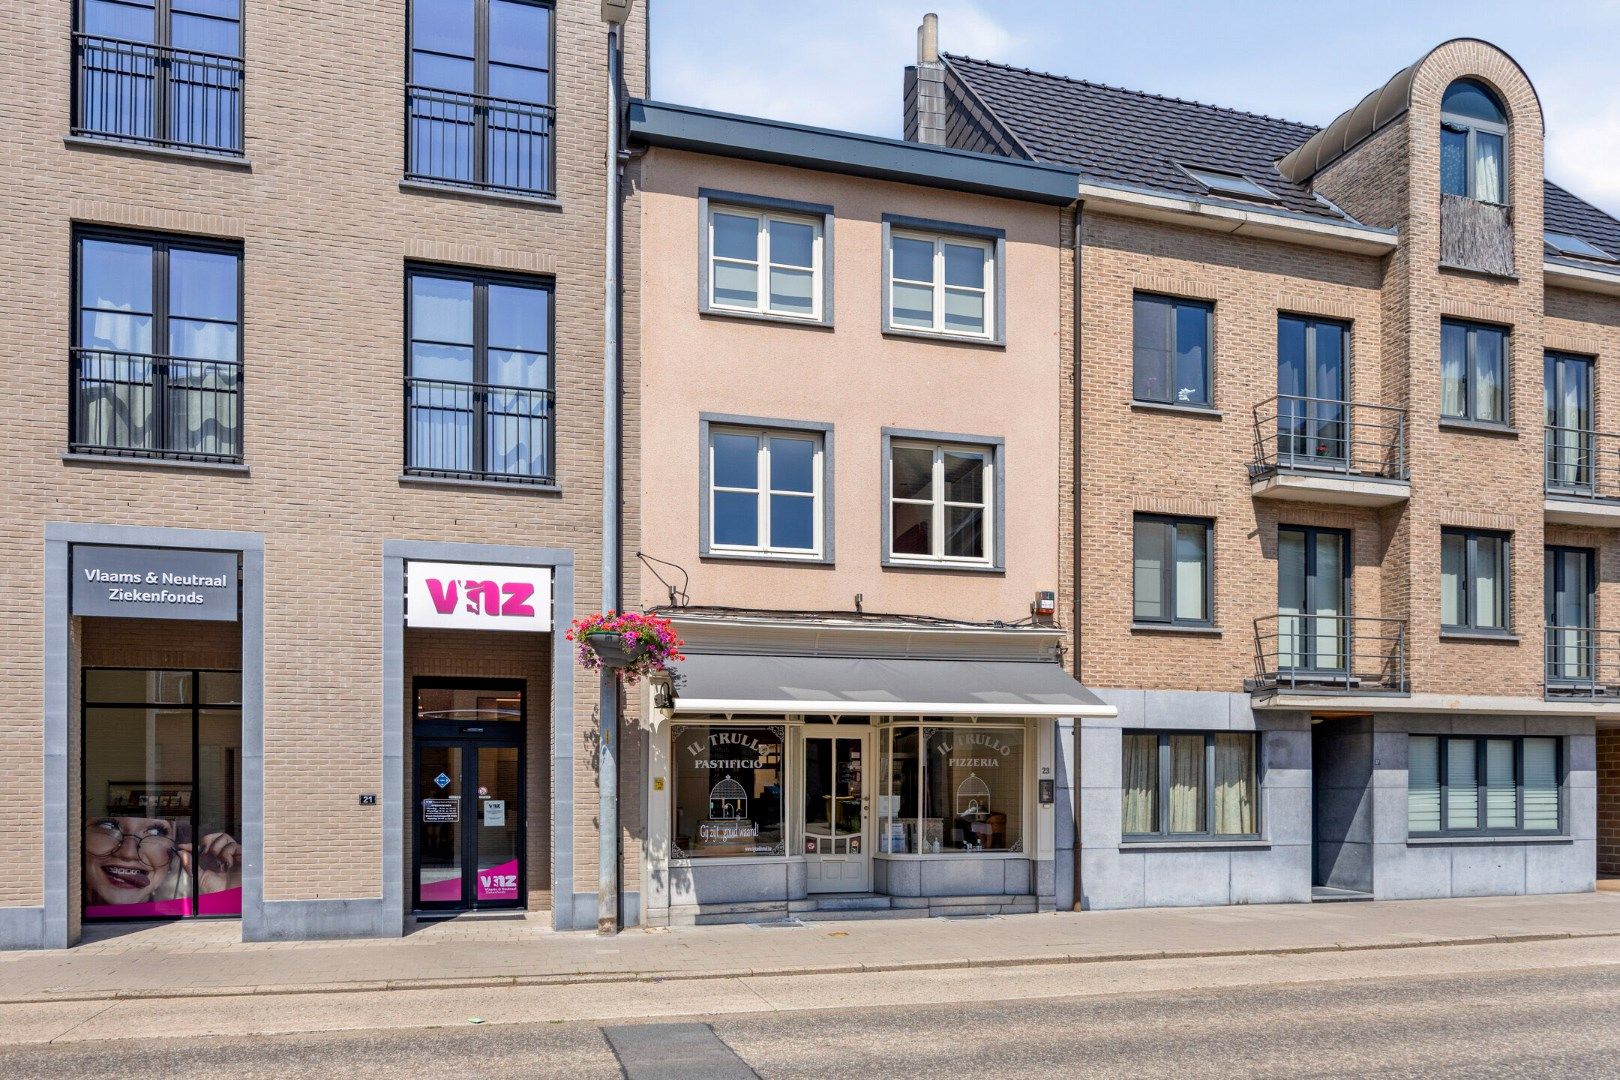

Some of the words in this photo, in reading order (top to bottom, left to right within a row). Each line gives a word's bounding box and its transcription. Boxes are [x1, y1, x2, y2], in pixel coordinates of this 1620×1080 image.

[84, 568, 142, 584] Vlaams
[145, 572, 159, 585] &
[162, 572, 227, 588] Neutraal
[108, 588, 204, 604] Ziekenfonds
[687, 741, 706, 757] IL
[708, 732, 771, 756] TRULLO
[936, 742, 953, 756] IL
[957, 733, 1011, 756] TRULLO
[694, 759, 763, 769] PASTIFICIO
[948, 758, 999, 767] PIZZERIA
